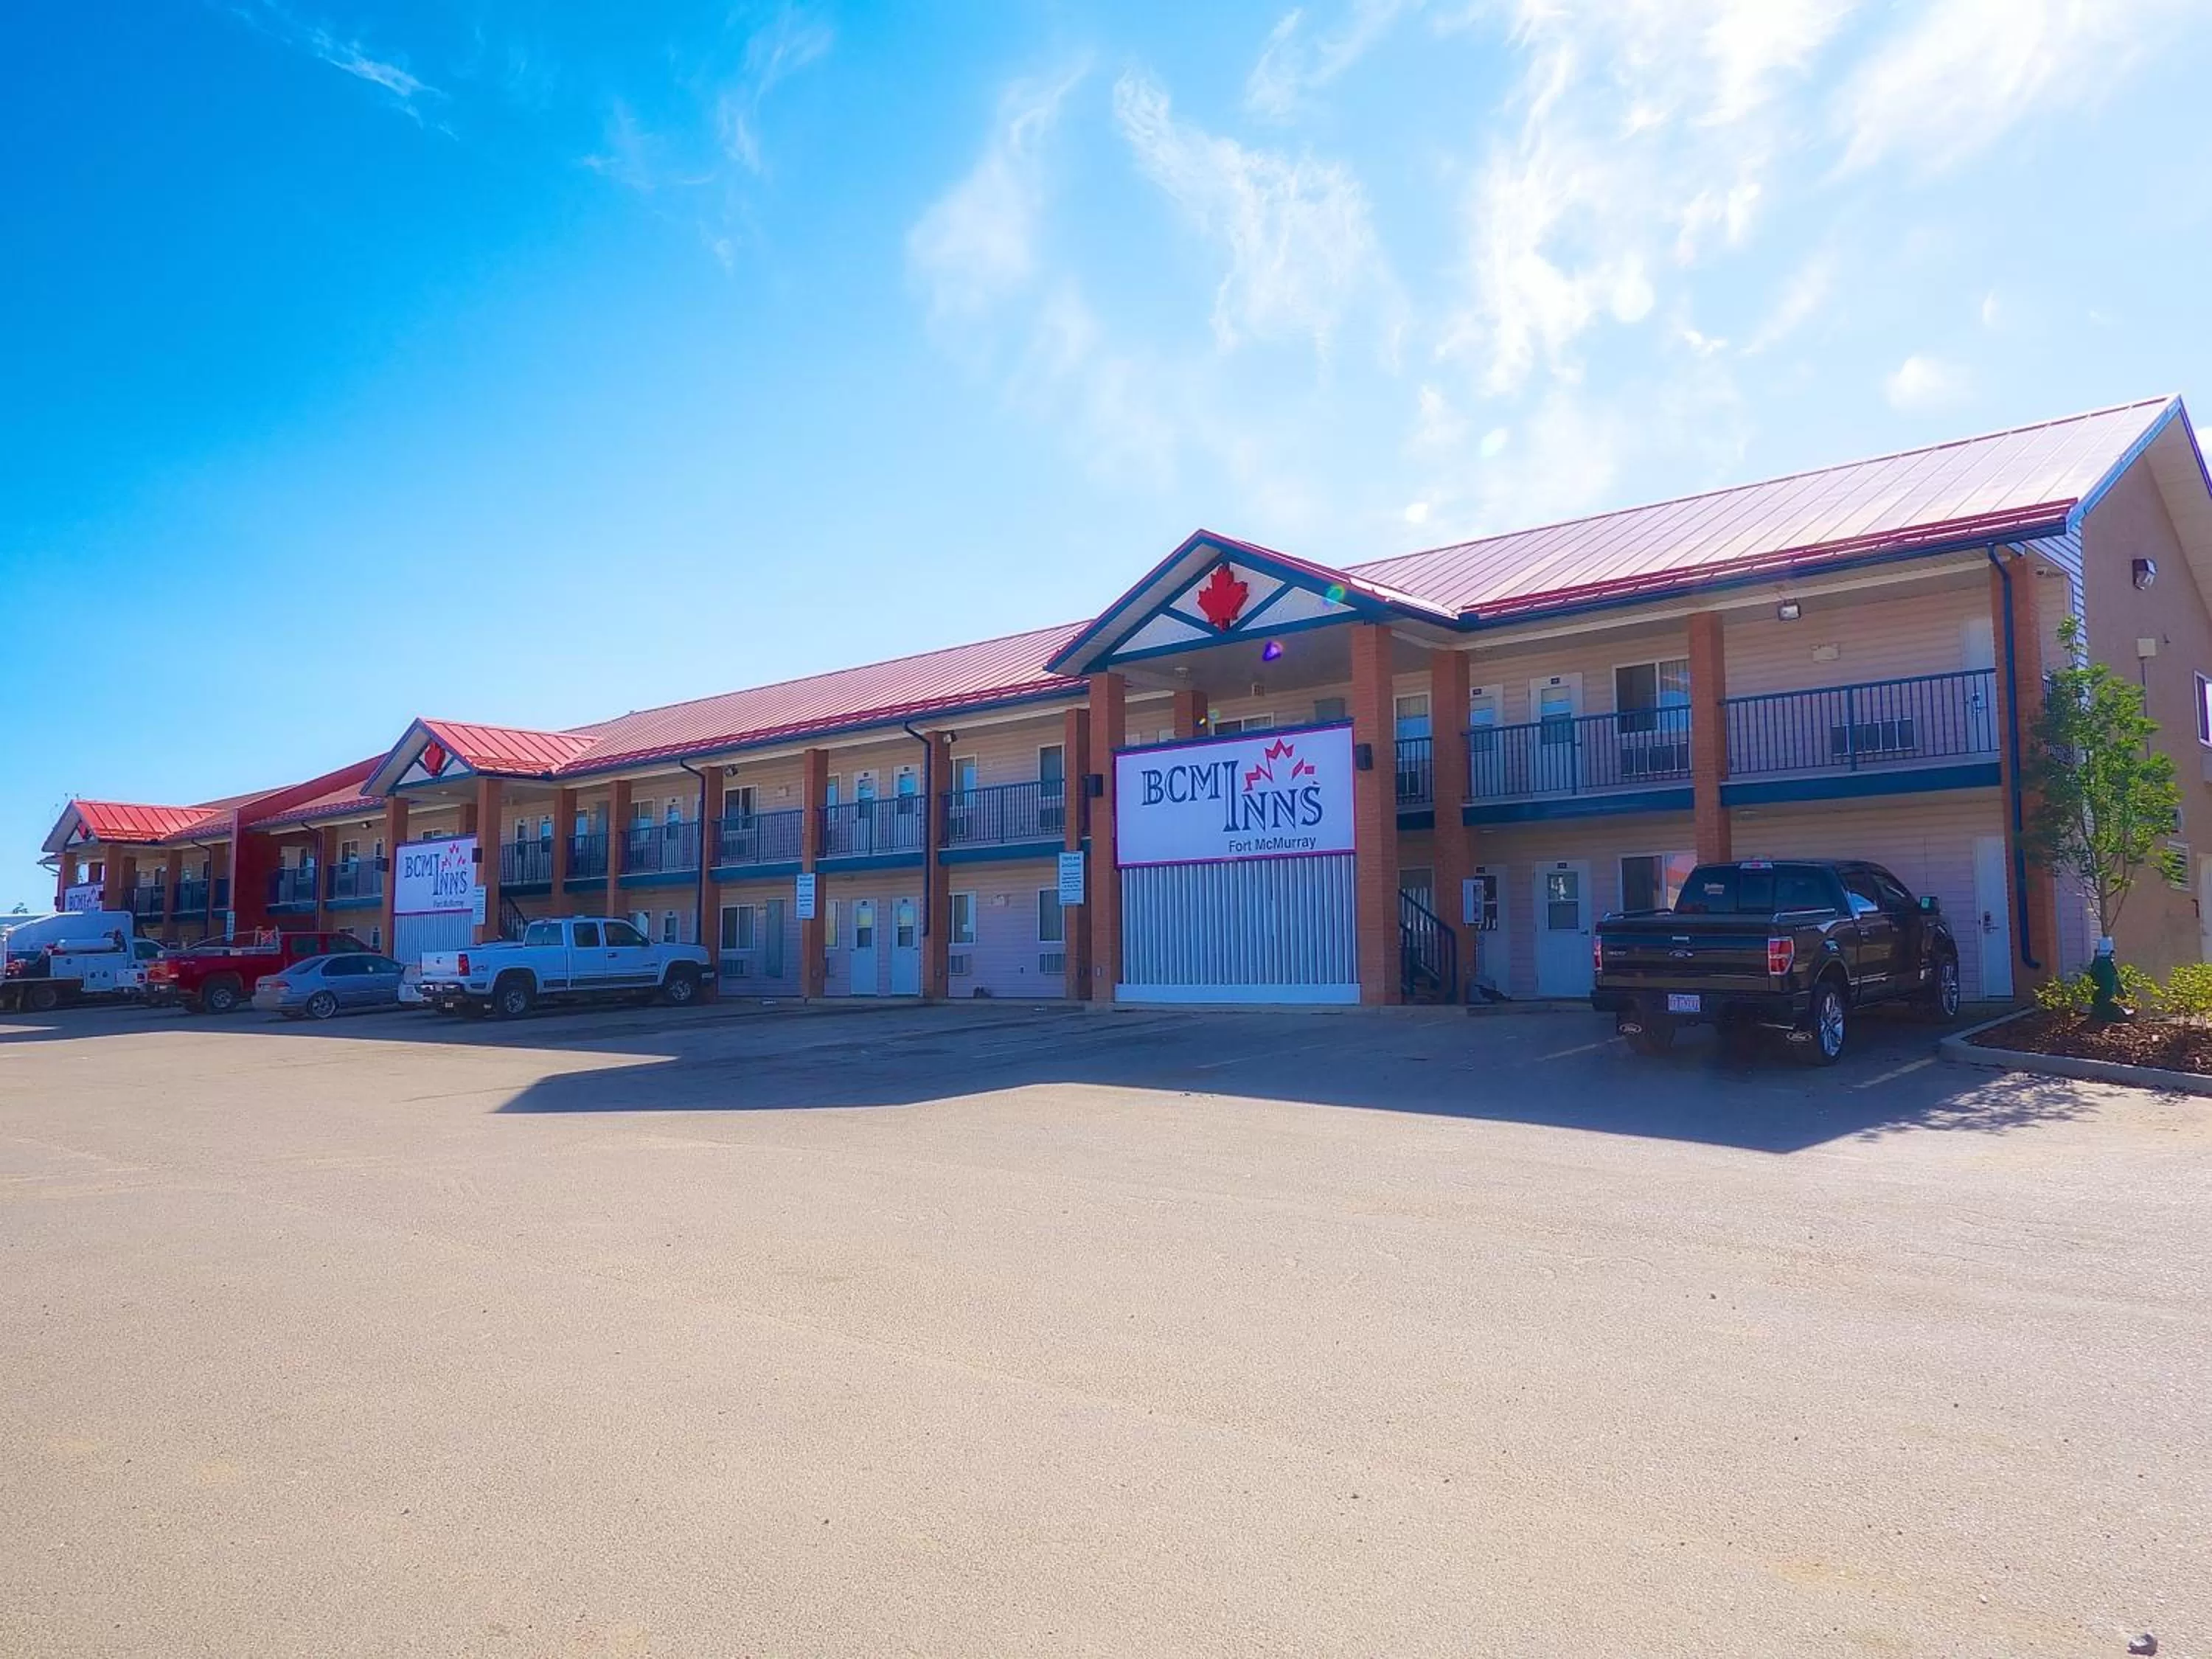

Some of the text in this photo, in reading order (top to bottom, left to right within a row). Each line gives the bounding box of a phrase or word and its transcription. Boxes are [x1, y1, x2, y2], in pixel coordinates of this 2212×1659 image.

[1141, 759, 1323, 832] BCM INNS
[1228, 836, 1316, 853] Fort McMurray
[404, 853, 467, 896] BCM INNS
